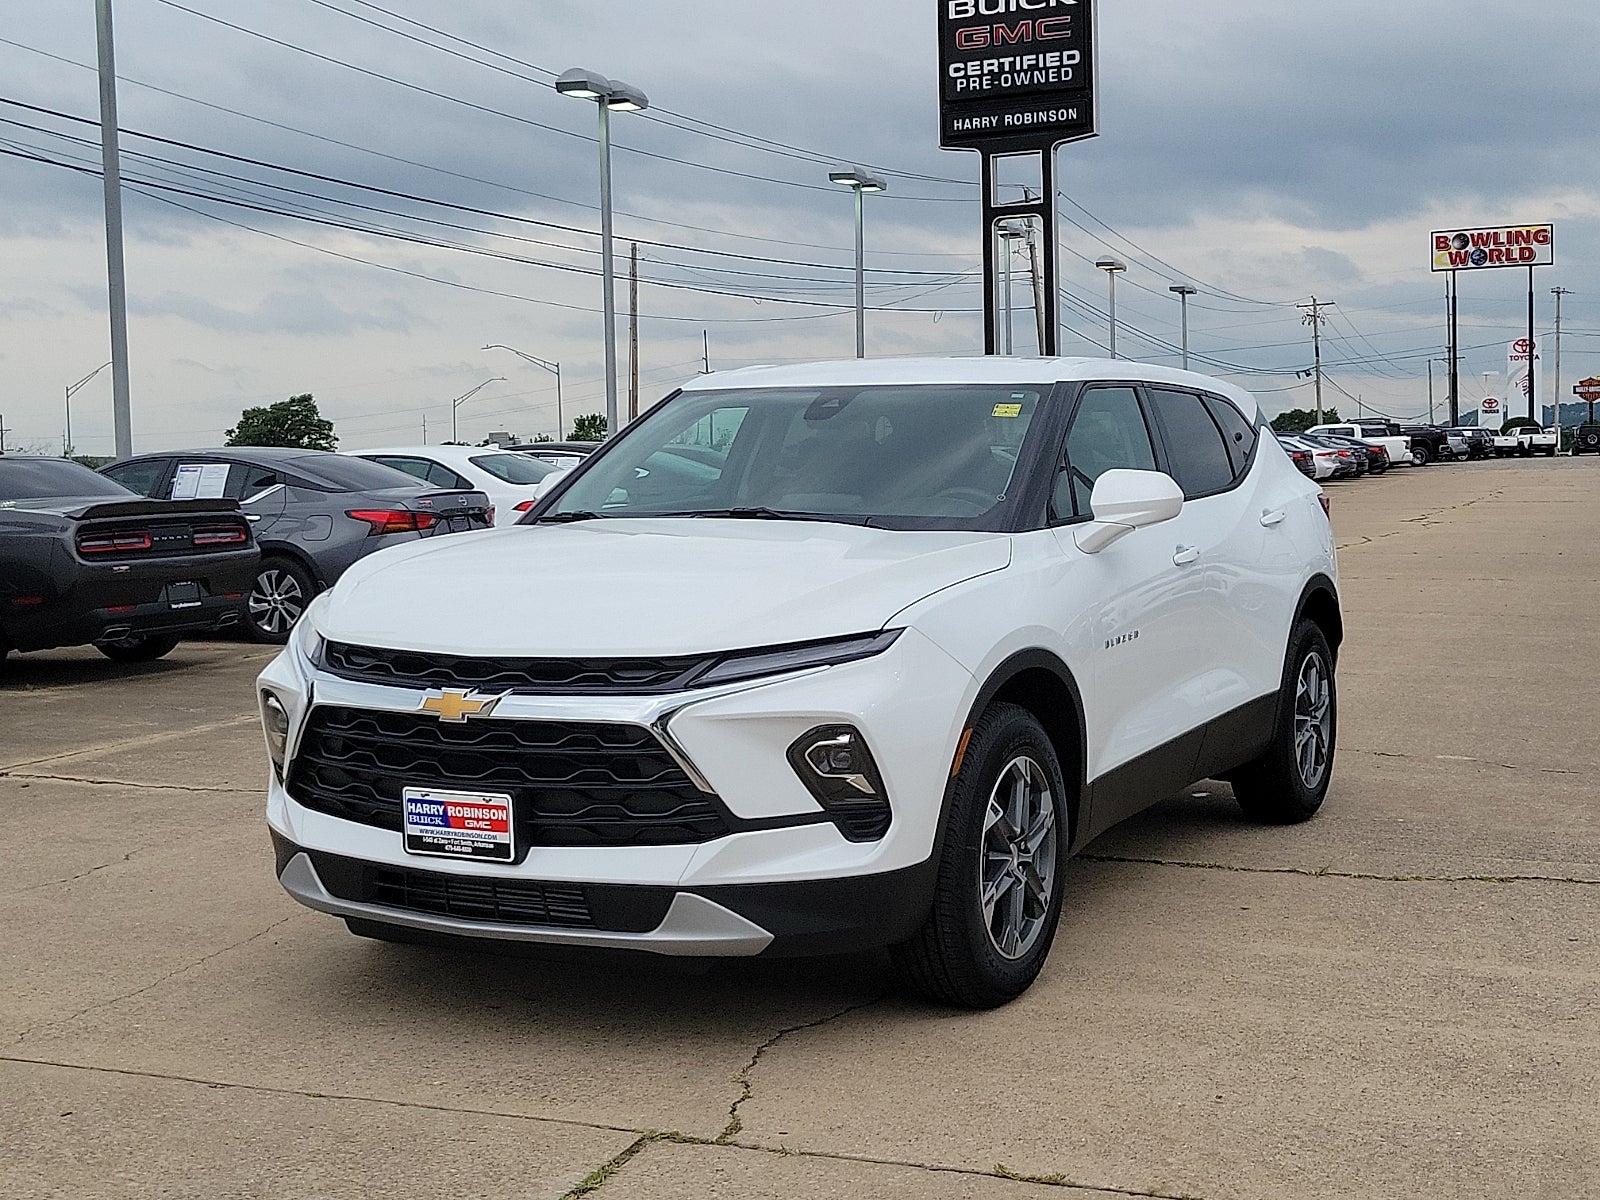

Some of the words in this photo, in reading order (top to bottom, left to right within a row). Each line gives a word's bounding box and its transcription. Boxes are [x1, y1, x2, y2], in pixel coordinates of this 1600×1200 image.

[956, 16, 1071, 49] GMC
[949, 50, 1080, 77] CERTIFIED
[956, 67, 1073, 92] PRE-OWNED
[954, 116, 998, 131] HARRY
[1004, 108, 1077, 126] ROBINSON
[1435, 229, 1550, 251] BOWLING
[1447, 246, 1536, 267] WORLD
[407, 802, 445, 816] HARRY
[447, 805, 507, 820] ROBINSON
[408, 815, 445, 825] BUICK
[419, 828, 498, 840] WWW.HARRYROBINSON.COM
[464, 820, 492, 829] GMC
